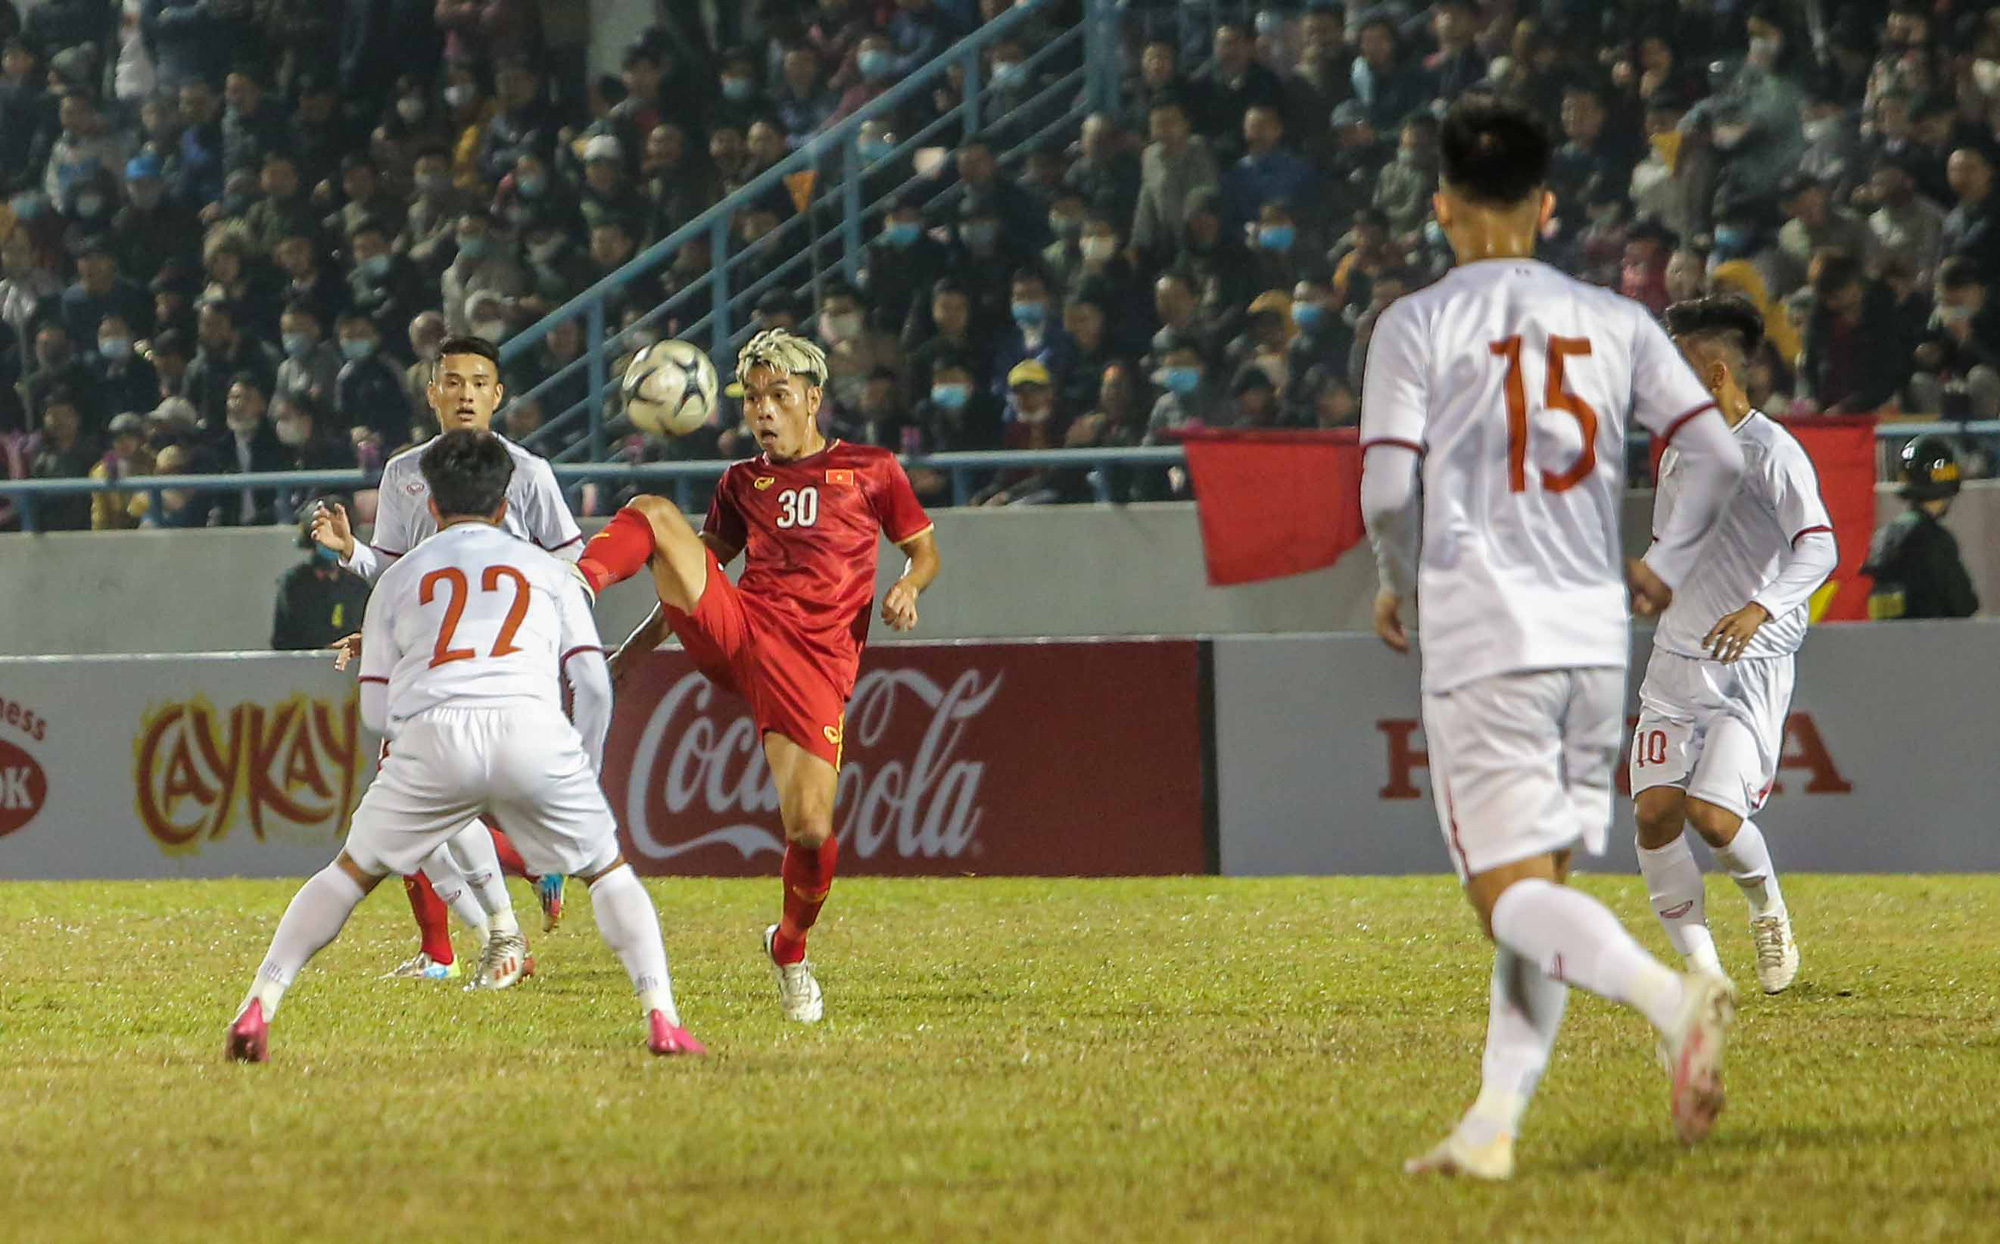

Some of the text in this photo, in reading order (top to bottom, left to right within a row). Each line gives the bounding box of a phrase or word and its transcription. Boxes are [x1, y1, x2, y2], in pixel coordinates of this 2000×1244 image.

[1488, 332, 1598, 494] 15
[775, 485, 819, 529] 30
[419, 564, 531, 670] 22
[0, 697, 47, 741] ess
[1636, 730, 1668, 768] 10
[0, 766, 33, 809] K
